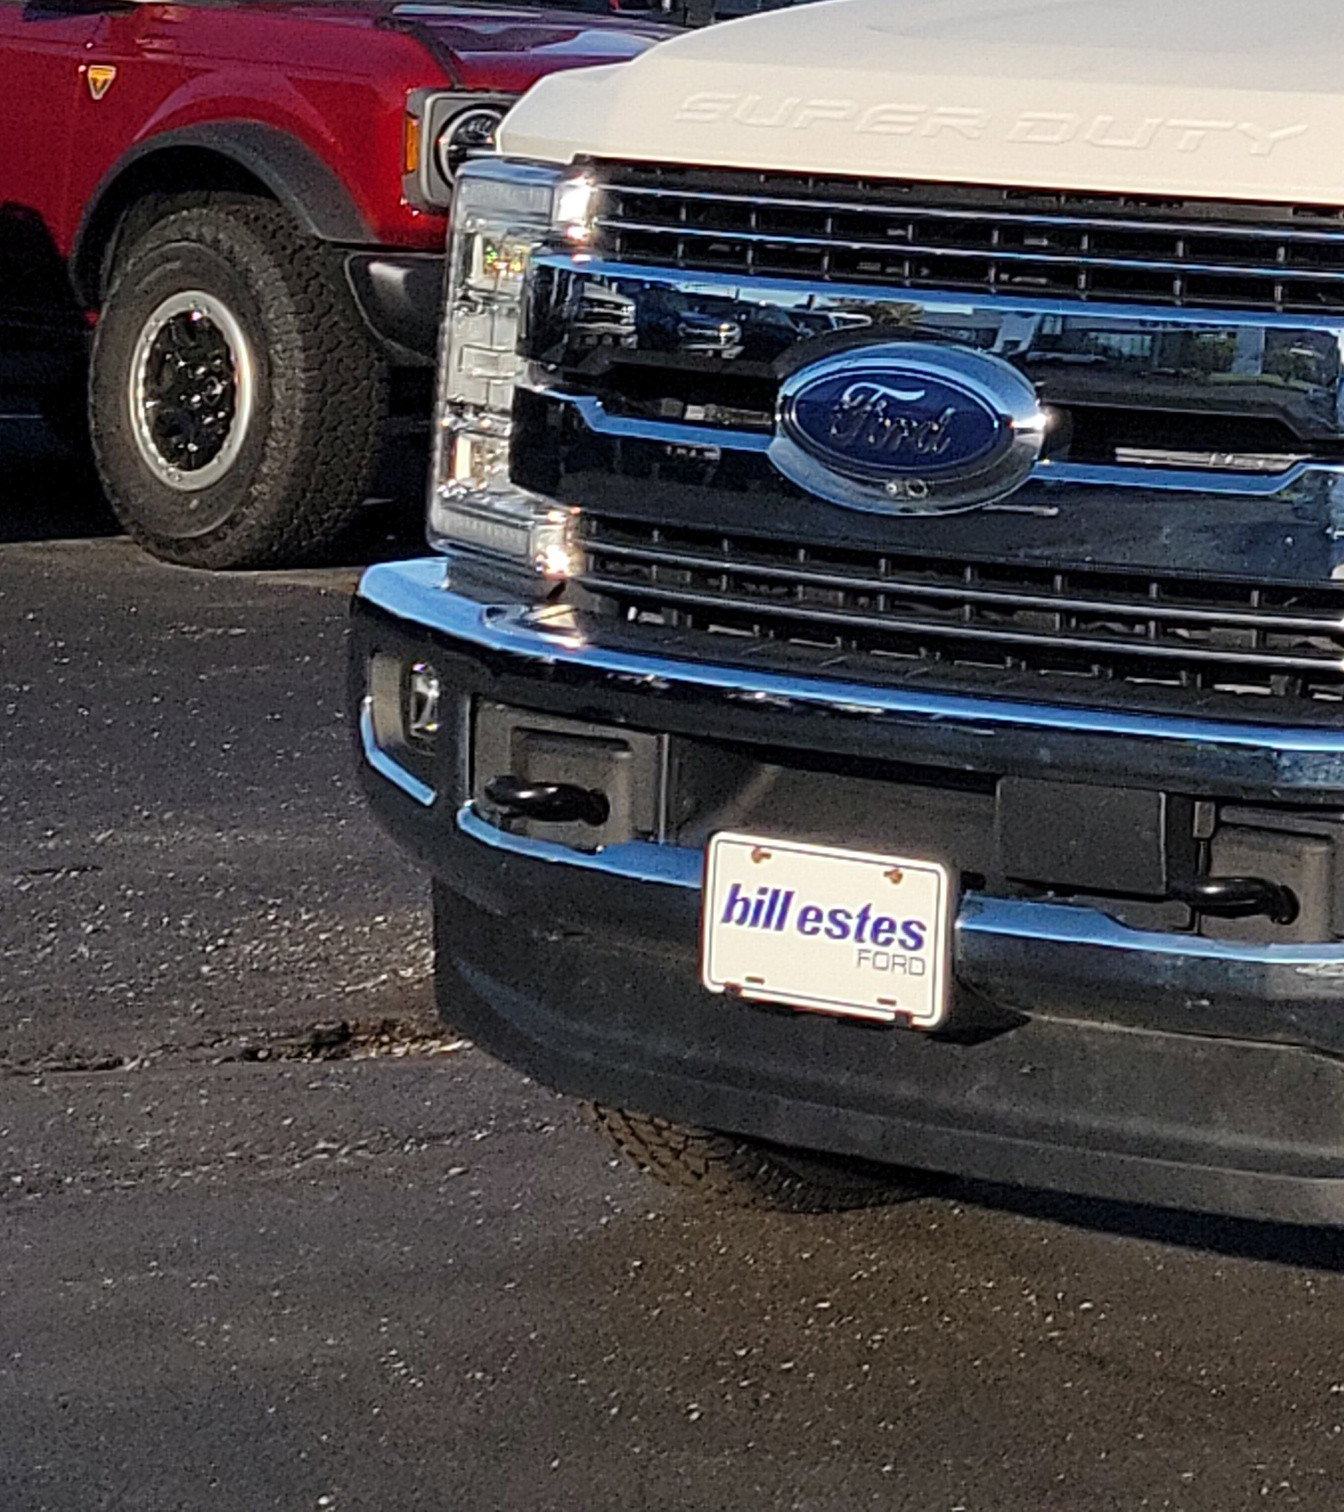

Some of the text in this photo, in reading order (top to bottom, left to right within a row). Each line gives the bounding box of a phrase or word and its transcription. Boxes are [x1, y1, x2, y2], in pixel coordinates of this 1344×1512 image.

[673, 92, 1308, 157] SUPER DUTY
[829, 381, 957, 455] Ford
[721, 884, 927, 950] bill estes
[857, 949, 926, 976] FORD
